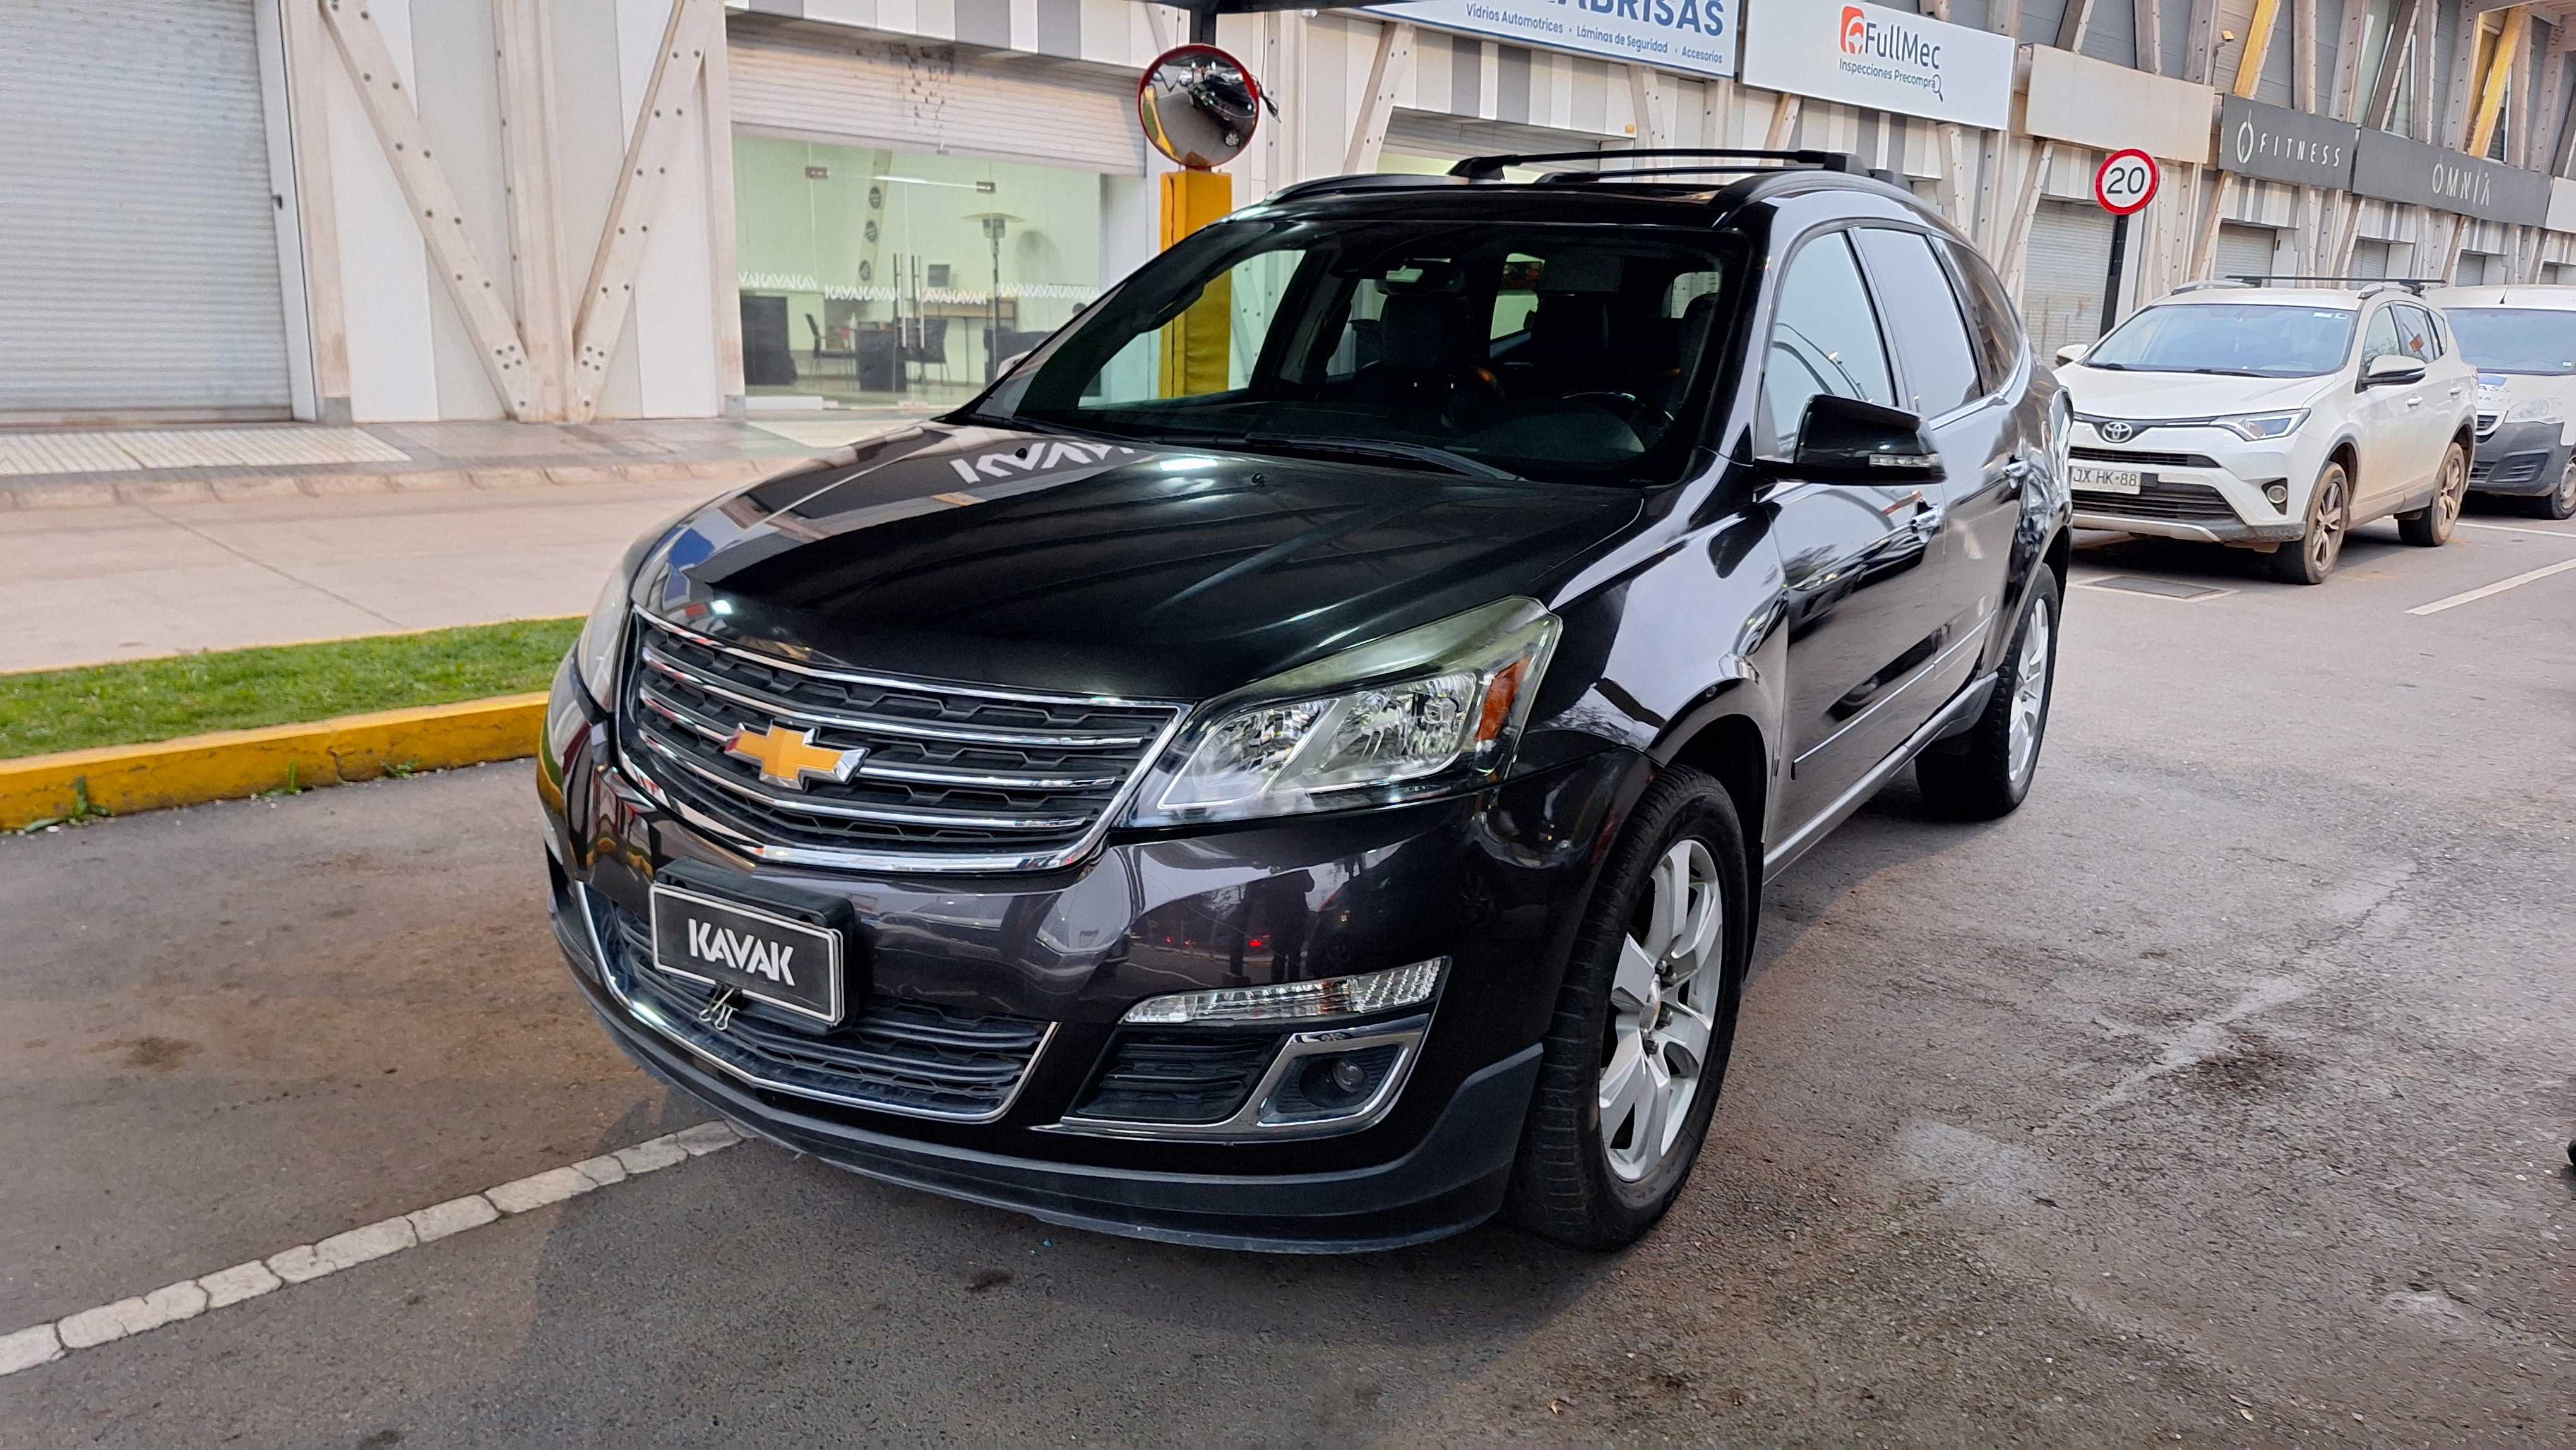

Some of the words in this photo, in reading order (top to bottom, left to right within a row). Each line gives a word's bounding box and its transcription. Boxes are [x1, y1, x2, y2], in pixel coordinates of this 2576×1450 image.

[1466, 3, 1500, 22] Vidrios
[1501, 11, 1563, 33] Automotrices
[1577, 25, 1613, 43] Láminas
[1615, 34, 1625, 45] de
[1626, 35, 1667, 53] Seguridad
[1682, 46, 1722, 64] Accesorios
[1865, 22, 1940, 69] FullMec
[1839, 58, 1892, 80] Inspecciones
[1894, 69, 1936, 89] Precompra
[2260, 133, 2341, 167] FITNESS
[2106, 167, 2145, 194] 20
[688, 918, 796, 987] KAVAK
